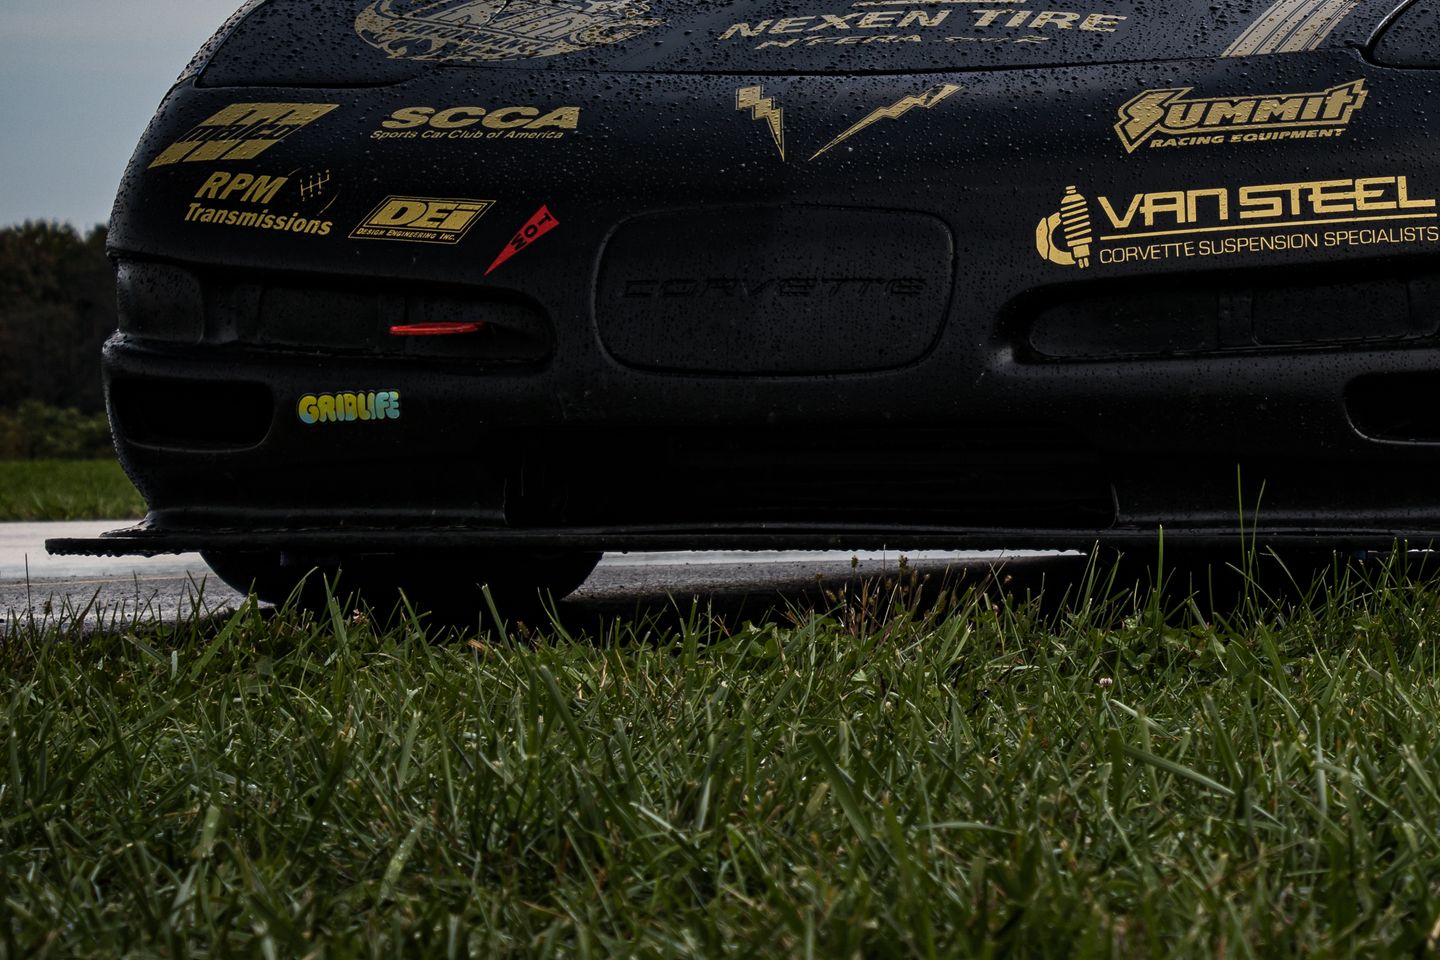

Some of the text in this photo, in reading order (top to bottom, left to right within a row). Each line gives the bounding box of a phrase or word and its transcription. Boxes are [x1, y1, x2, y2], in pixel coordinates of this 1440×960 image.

[717, 8, 1128, 40] NEXEN TIRE
[381, 106, 582, 129] SCCA
[369, 130, 565, 141] Sports Car Club of America
[1149, 127, 1348, 149] RACING EQUIPMENT
[193, 170, 289, 205] RPM
[1097, 175, 1437, 229] VAN STEEL
[183, 202, 334, 237] Transmissions
[510, 212, 553, 250] TOW
[1099, 225, 1440, 265] CORVETTE SUSPENSION SPECIALISTS
[624, 277, 927, 299] CORVETTE
[296, 390, 401, 424] GRIDLIFE
